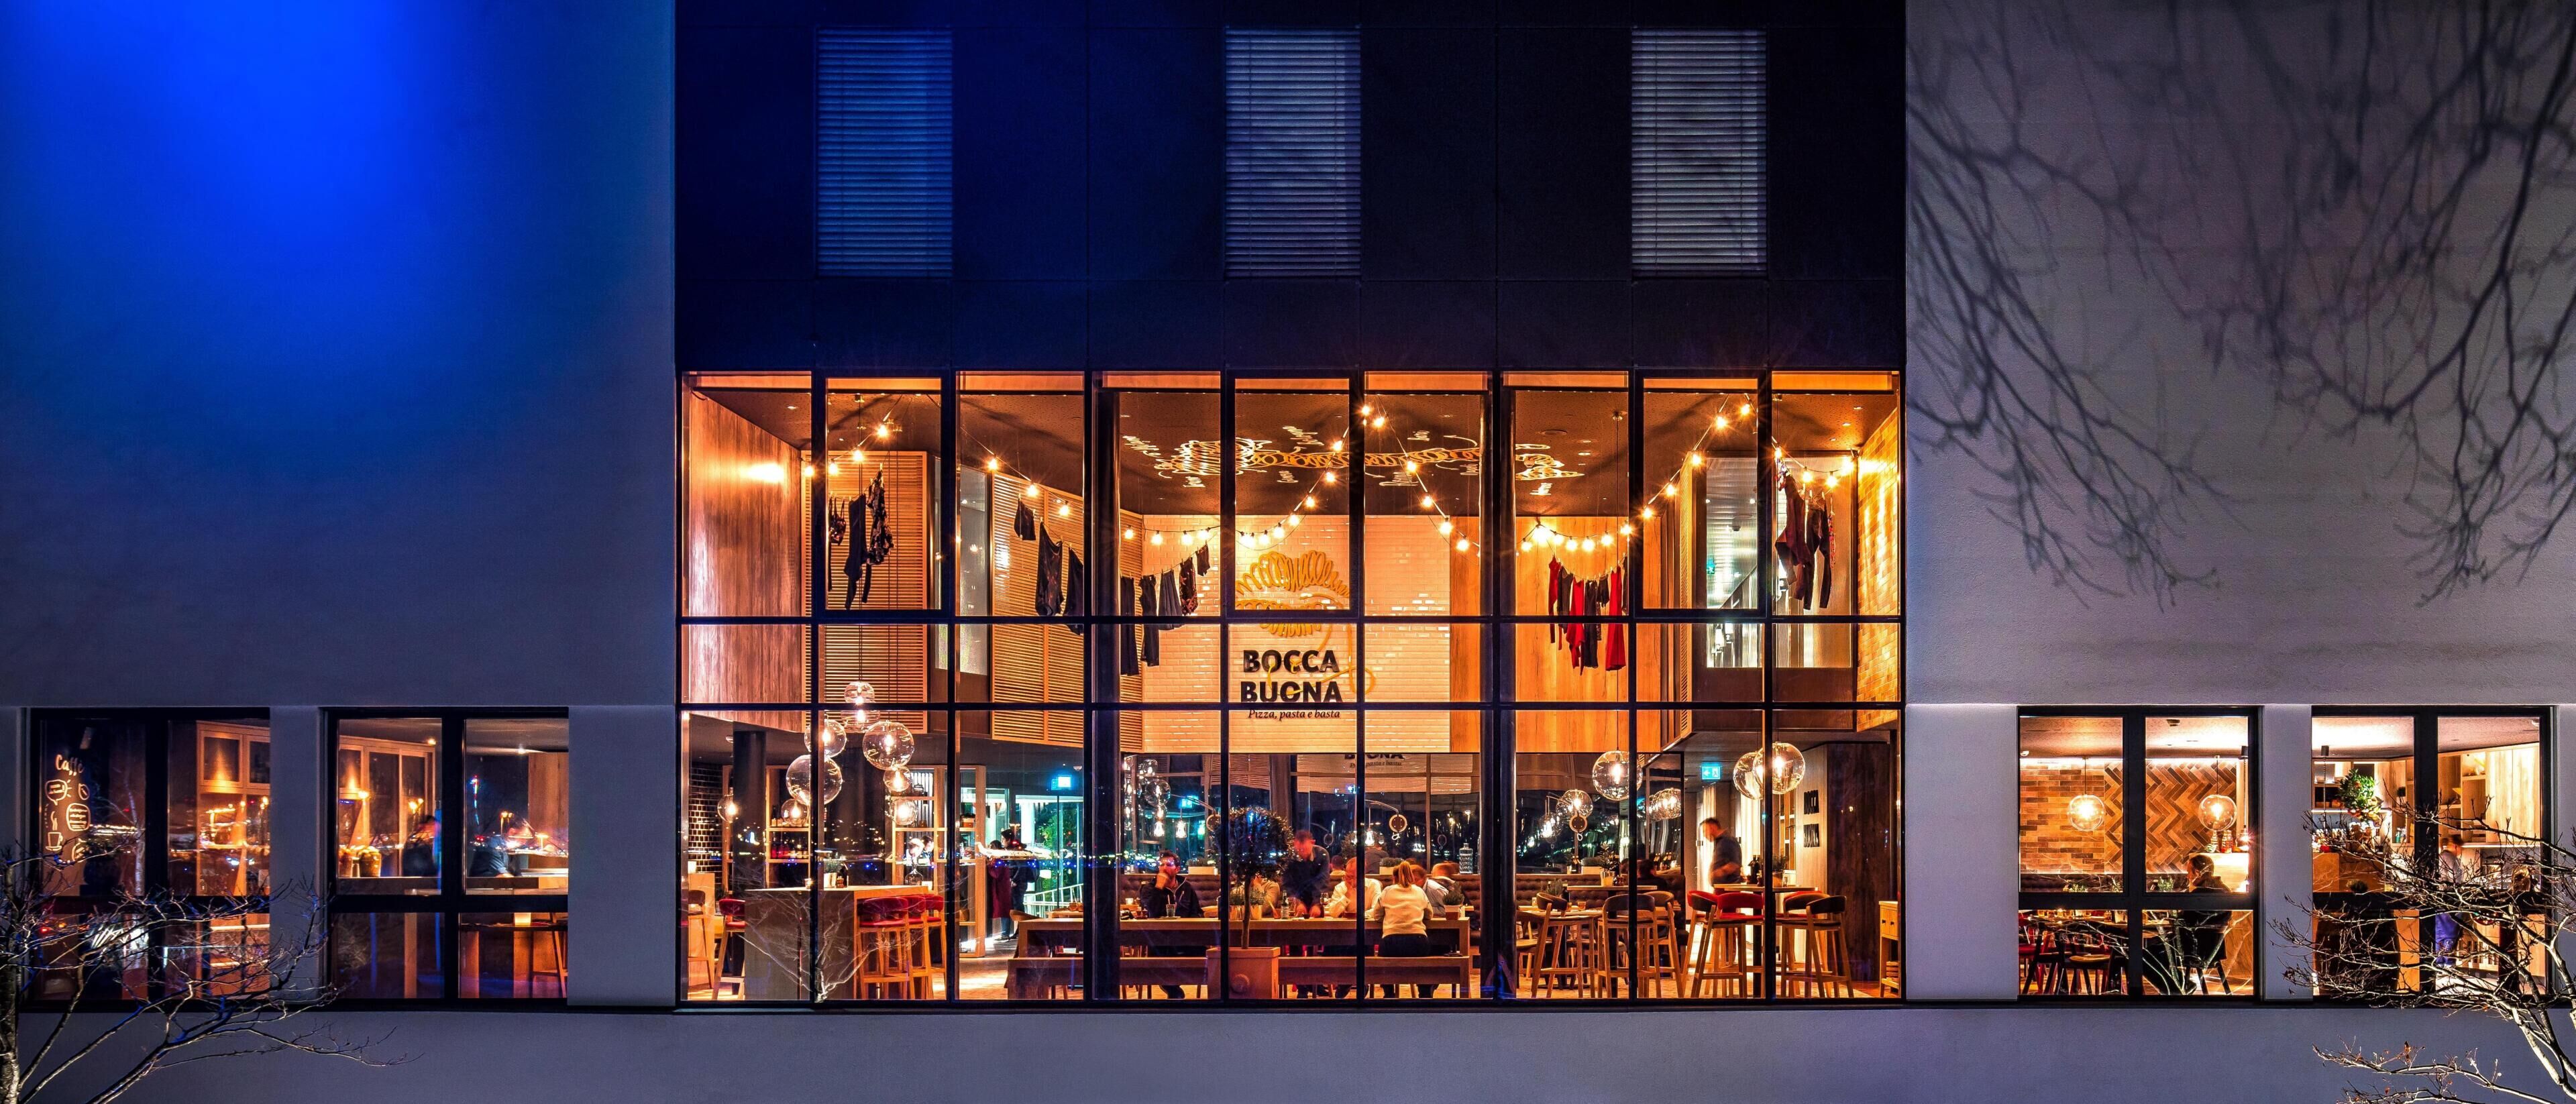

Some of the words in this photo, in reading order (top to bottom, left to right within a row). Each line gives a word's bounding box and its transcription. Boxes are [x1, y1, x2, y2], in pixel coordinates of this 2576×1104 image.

[1243, 649, 1340, 673] BOCCA
[1241, 681, 1343, 702] BUONA
[1248, 709, 1277, 720] Pizza,
[1279, 710, 1305, 721] pasta
[1307, 711, 1313, 719] e
[1314, 709, 1340, 719] basta
